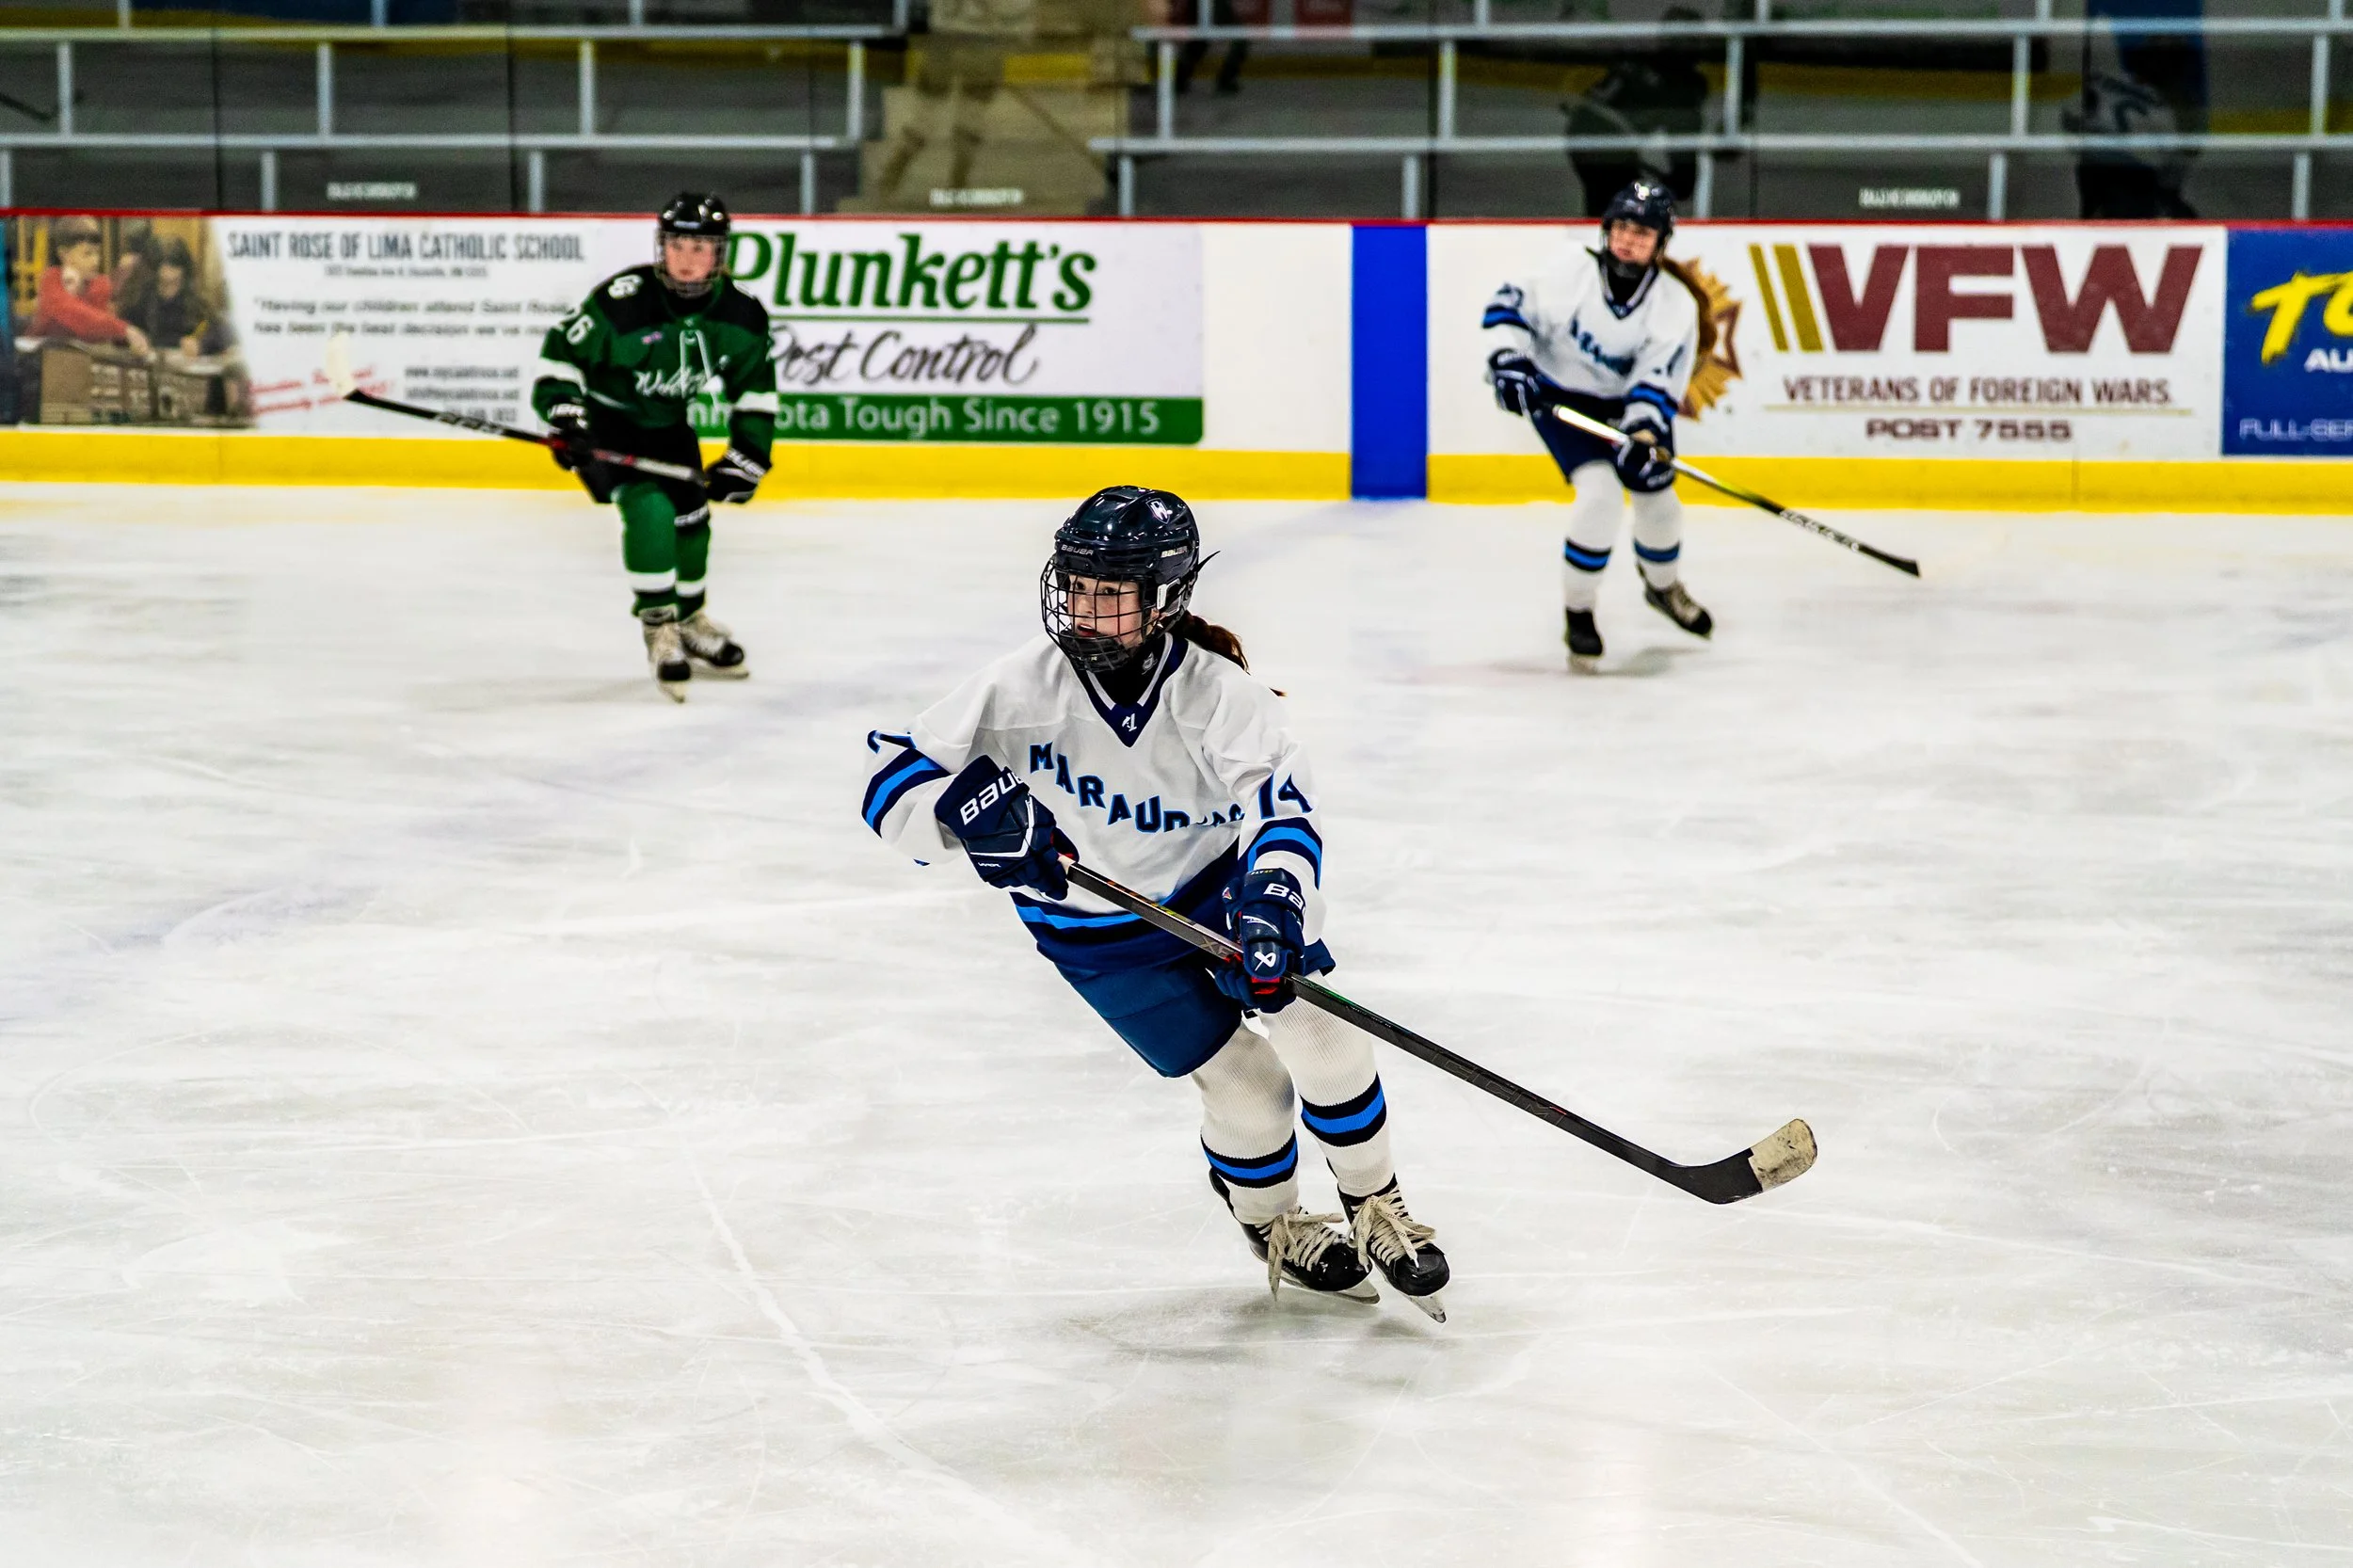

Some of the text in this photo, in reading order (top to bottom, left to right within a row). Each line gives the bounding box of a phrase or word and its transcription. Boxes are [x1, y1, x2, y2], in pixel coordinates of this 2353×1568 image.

[228, 232, 584, 261] SAINT ROSE OF LIMA CATHOLIC SCHOOL
[728, 232, 1097, 312] Plunkett's
[1807, 244, 2203, 354] VFW
[858, 324, 1040, 386] Control
[1782, 376, 1920, 403] VETERANS
[1929, 376, 1959, 403] OF
[1969, 376, 2082, 404] FOREIGN
[842, 398, 958, 440] Tough
[962, 399, 1061, 434] Since
[1075, 401, 1160, 435] 1915
[1865, 419, 1962, 440] POST
[1257, 771, 1314, 820] 14
